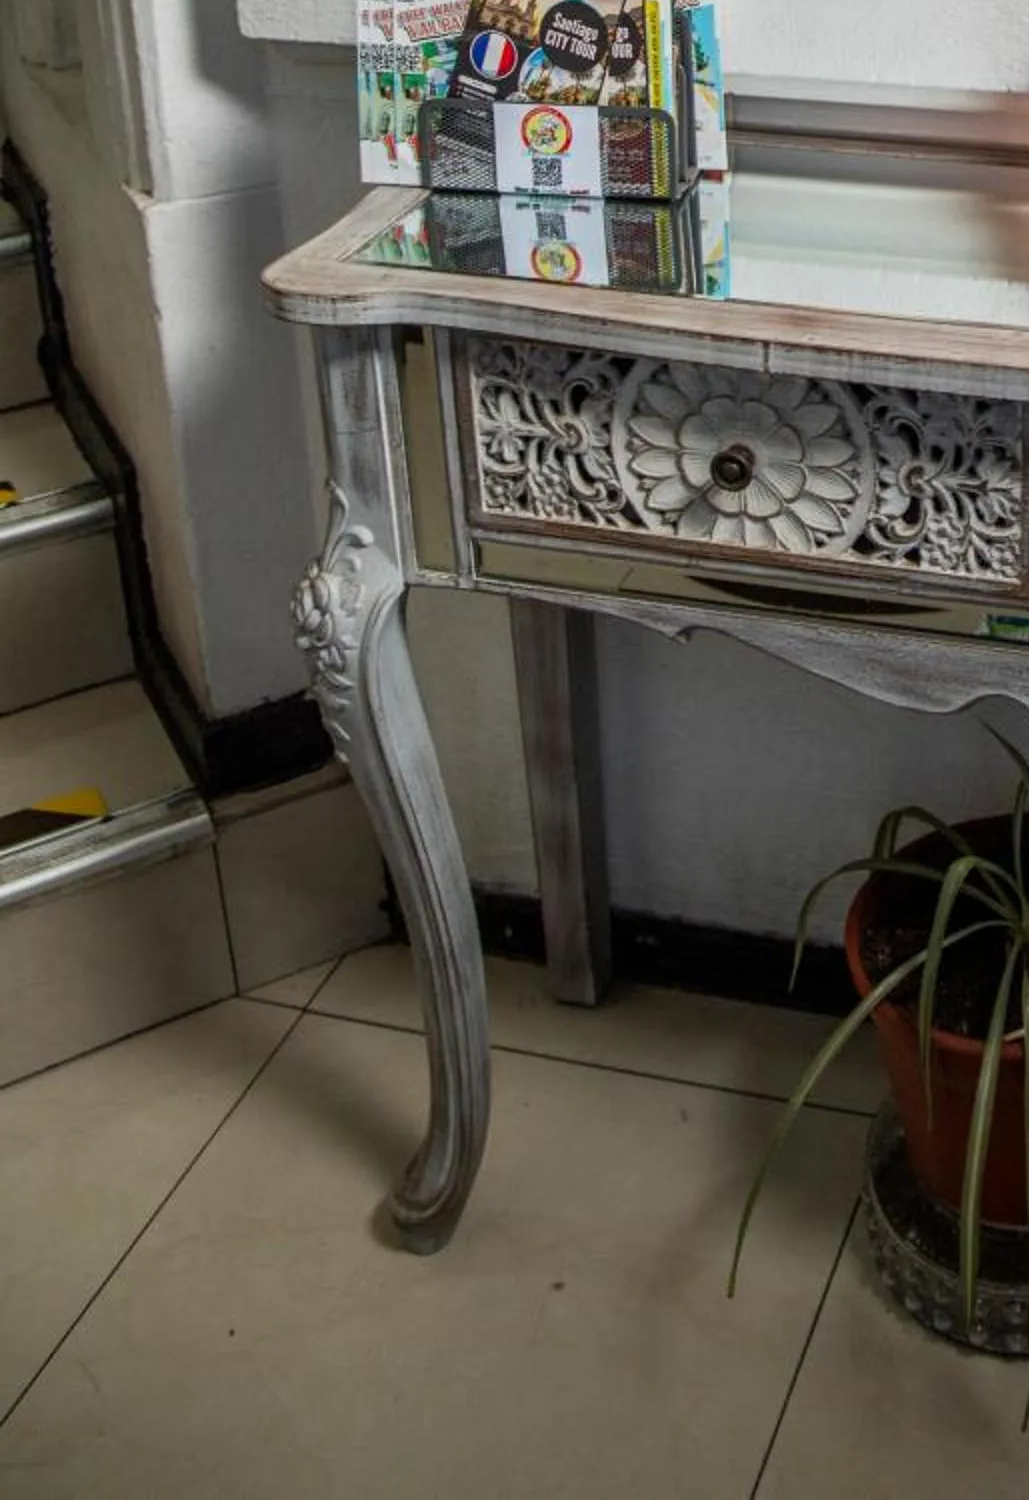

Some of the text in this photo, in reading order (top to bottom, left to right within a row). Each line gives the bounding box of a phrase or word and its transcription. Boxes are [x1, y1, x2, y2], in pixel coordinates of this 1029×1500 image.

[552, 11, 599, 43] Santiago
[545, 29, 597, 61] CITY TOUR
